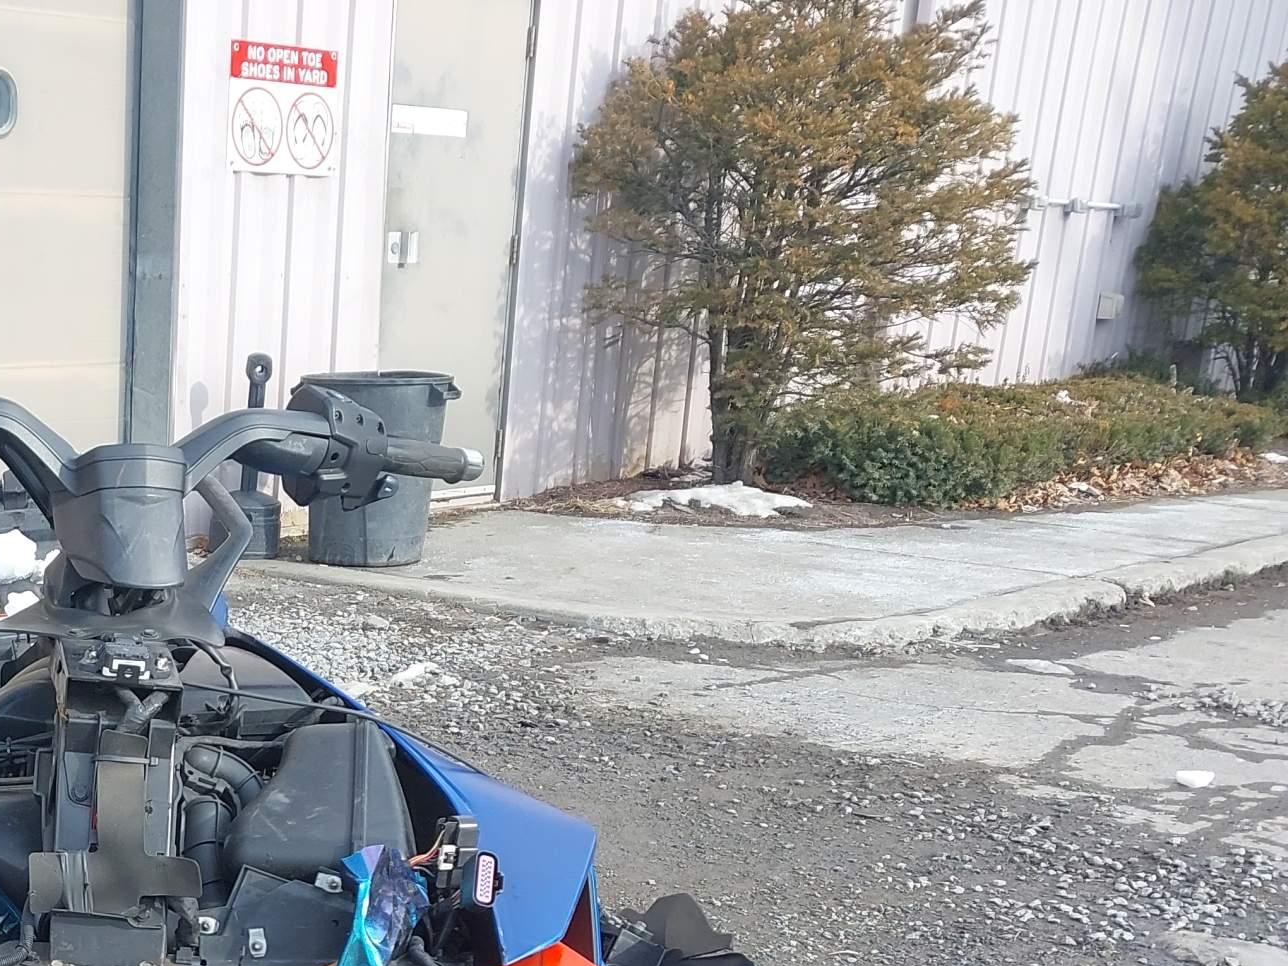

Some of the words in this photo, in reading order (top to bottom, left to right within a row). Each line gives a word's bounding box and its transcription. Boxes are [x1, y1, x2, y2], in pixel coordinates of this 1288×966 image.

[247, 45, 265, 61] NO
[267, 47, 299, 65] OPEN
[302, 51, 322, 68] TOE
[241, 61, 280, 80] SHOES
[283, 66, 296, 82] IN
[298, 67, 328, 85] YARD
